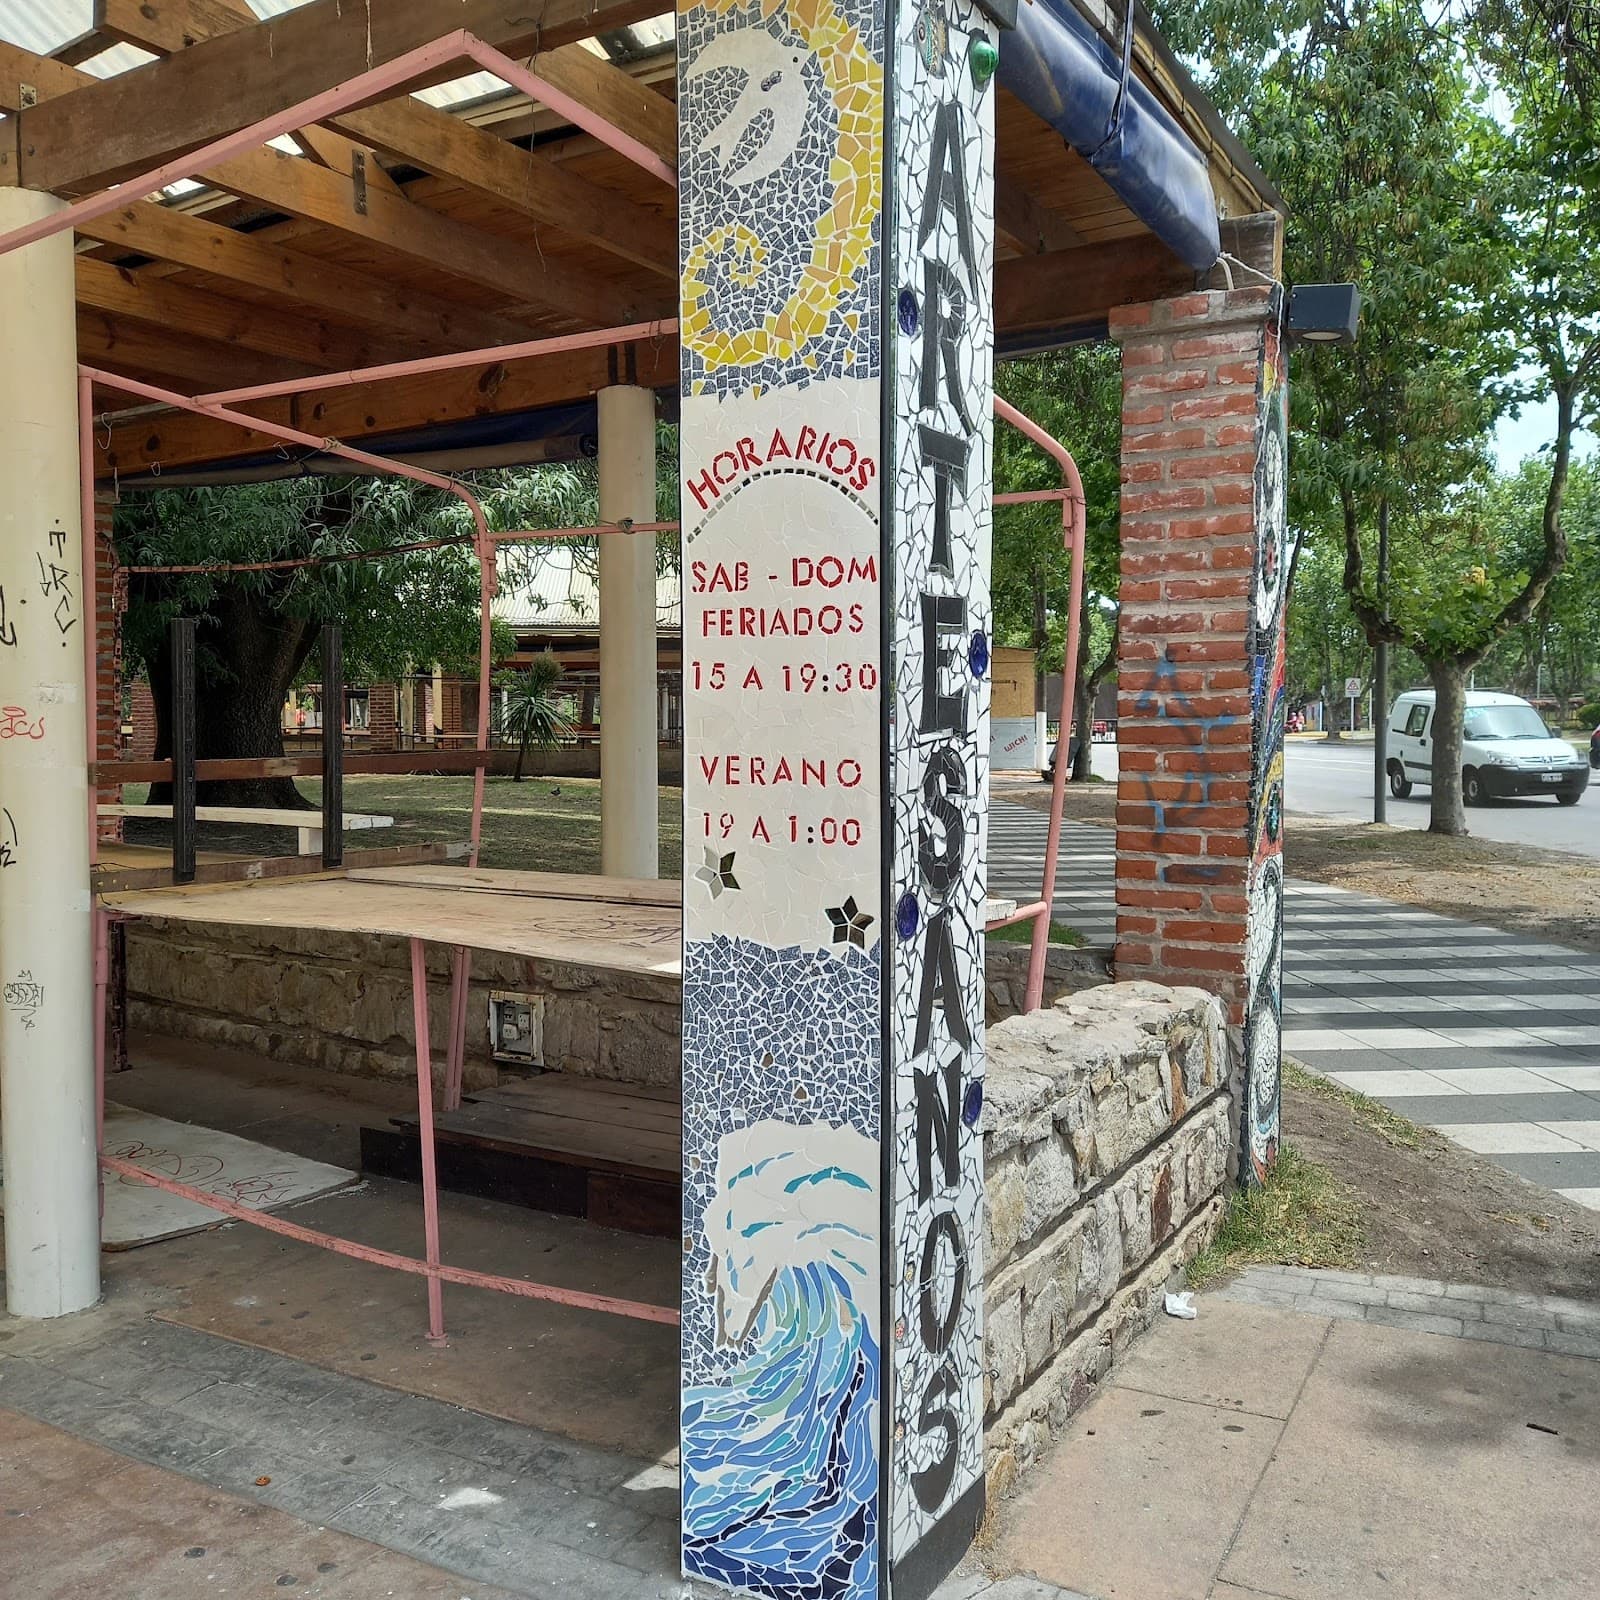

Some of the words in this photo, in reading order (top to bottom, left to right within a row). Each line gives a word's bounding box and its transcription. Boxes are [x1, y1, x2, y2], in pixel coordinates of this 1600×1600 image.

[686, 425, 876, 510] HORARIOS
[691, 560, 749, 593] SAB
[791, 555, 877, 589] DOM
[702, 603, 864, 637] FERIADOS
[691, 660, 726, 690] 15
[742, 665, 763, 690] A
[782, 662, 877, 693] 19:30
[699, 754, 862, 788] VERANO
[909, 99, 977, 1514] ARTESANOS
[703, 812, 734, 839] 19
[751, 815, 771, 844] A
[787, 814, 862, 846] 1:00
